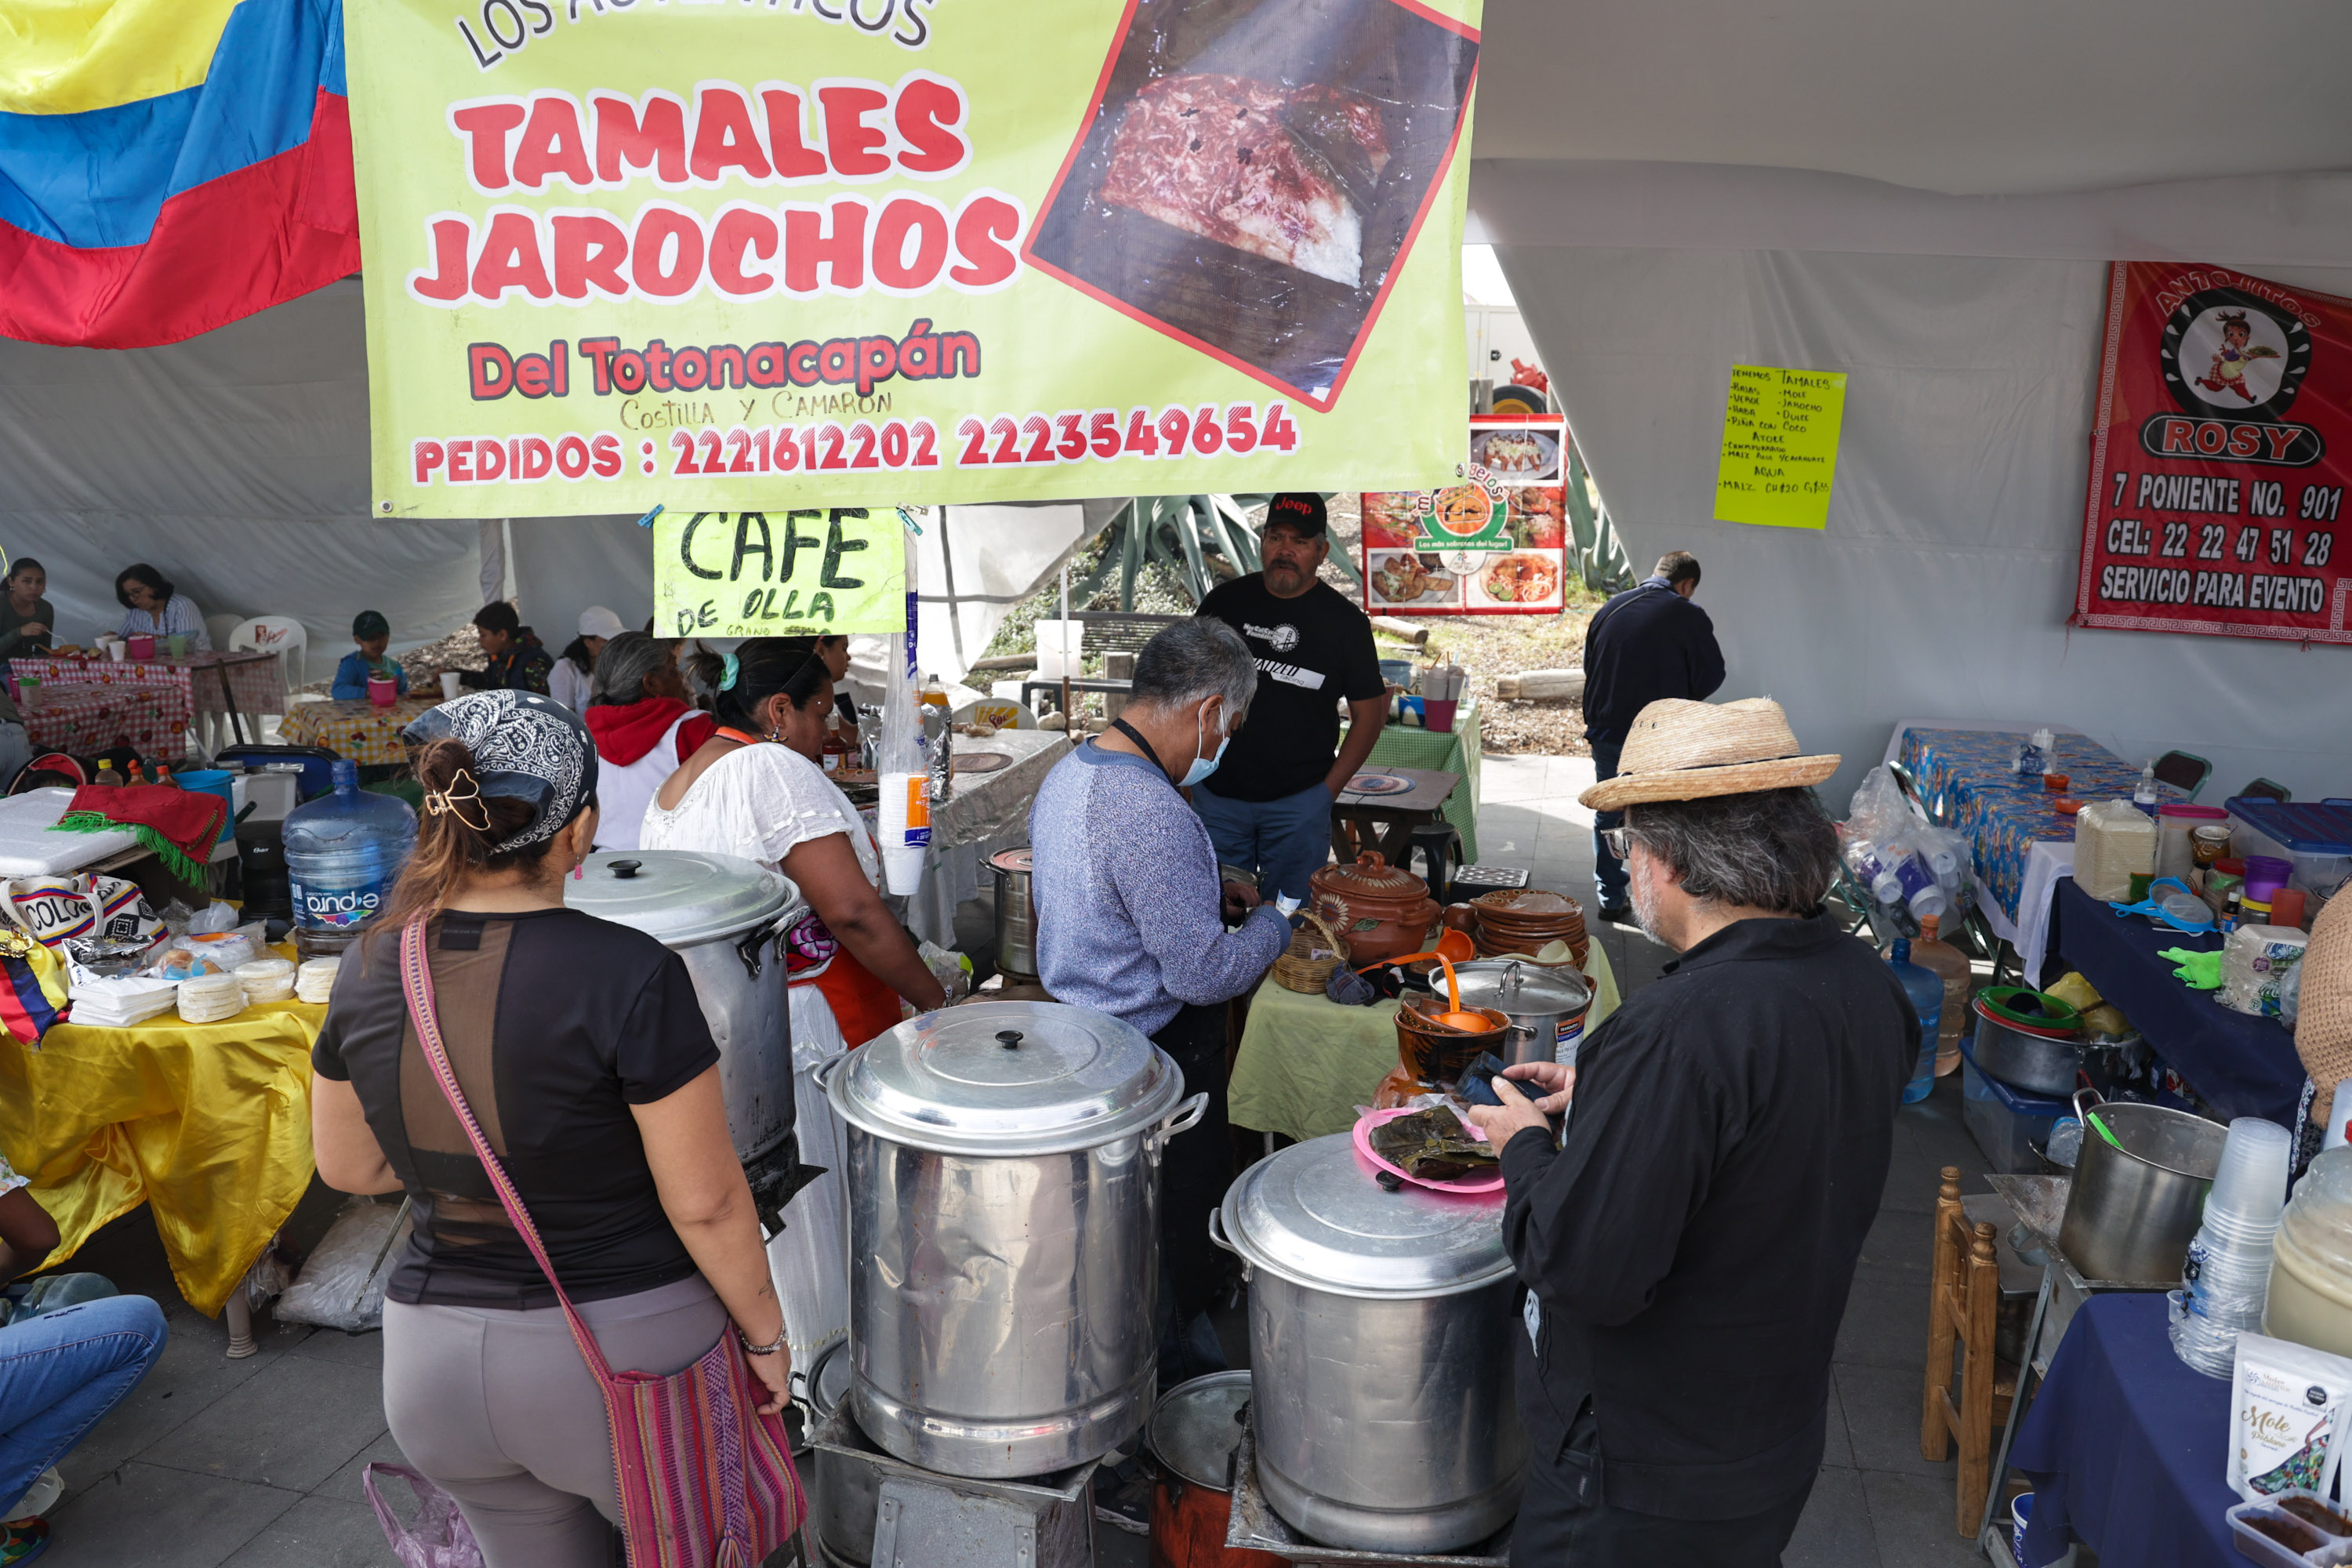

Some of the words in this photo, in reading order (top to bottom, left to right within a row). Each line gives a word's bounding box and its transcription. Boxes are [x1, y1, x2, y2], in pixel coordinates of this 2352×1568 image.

[459, 0, 553, 68] LOS
[453, 78, 965, 189] TAMALES
[413, 198, 1019, 300] JAROCHOS
[2156, 270, 2321, 328] ANTOJITOS
[469, 338, 568, 400] Del
[580, 318, 982, 401] Totonacapán
[1732, 369, 1771, 381] TENEMOS
[1775, 369, 1831, 390] TAMALES
[1733, 394, 1759, 405] VERDE
[1784, 390, 1806, 398] MOLE
[415, 434, 622, 483] PEDIDOS
[673, 422, 938, 475] 2221612202
[958, 405, 1296, 465] 2223549654
[1752, 431, 1785, 443] ATOLE
[2162, 419, 2303, 460] ROSY
[1754, 466, 1785, 477] AGUA
[1276, 496, 1312, 515] Jeep
[2114, 474, 2128, 507] 7
[2139, 474, 2239, 513] PONIENTE
[2251, 481, 2285, 517] NO.
[2300, 485, 2343, 521] 901
[681, 508, 869, 588] CAFE
[2107, 520, 2151, 554] CEL:
[2161, 523, 2189, 557] 22
[2199, 524, 2226, 558] 22
[2236, 527, 2259, 561] 47
[2270, 529, 2292, 564] 51
[2303, 532, 2332, 566] 28
[2100, 565, 2190, 603] SERVICIO
[2194, 572, 2245, 608] PARA
[2249, 575, 2324, 612] EVENTO
[677, 599, 719, 637] DE
[742, 588, 835, 622] OLLA
[1279, 674, 1305, 685] racing
[2241, 1406, 2291, 1434] Mole
[2251, 1431, 2287, 1448] Poblano
